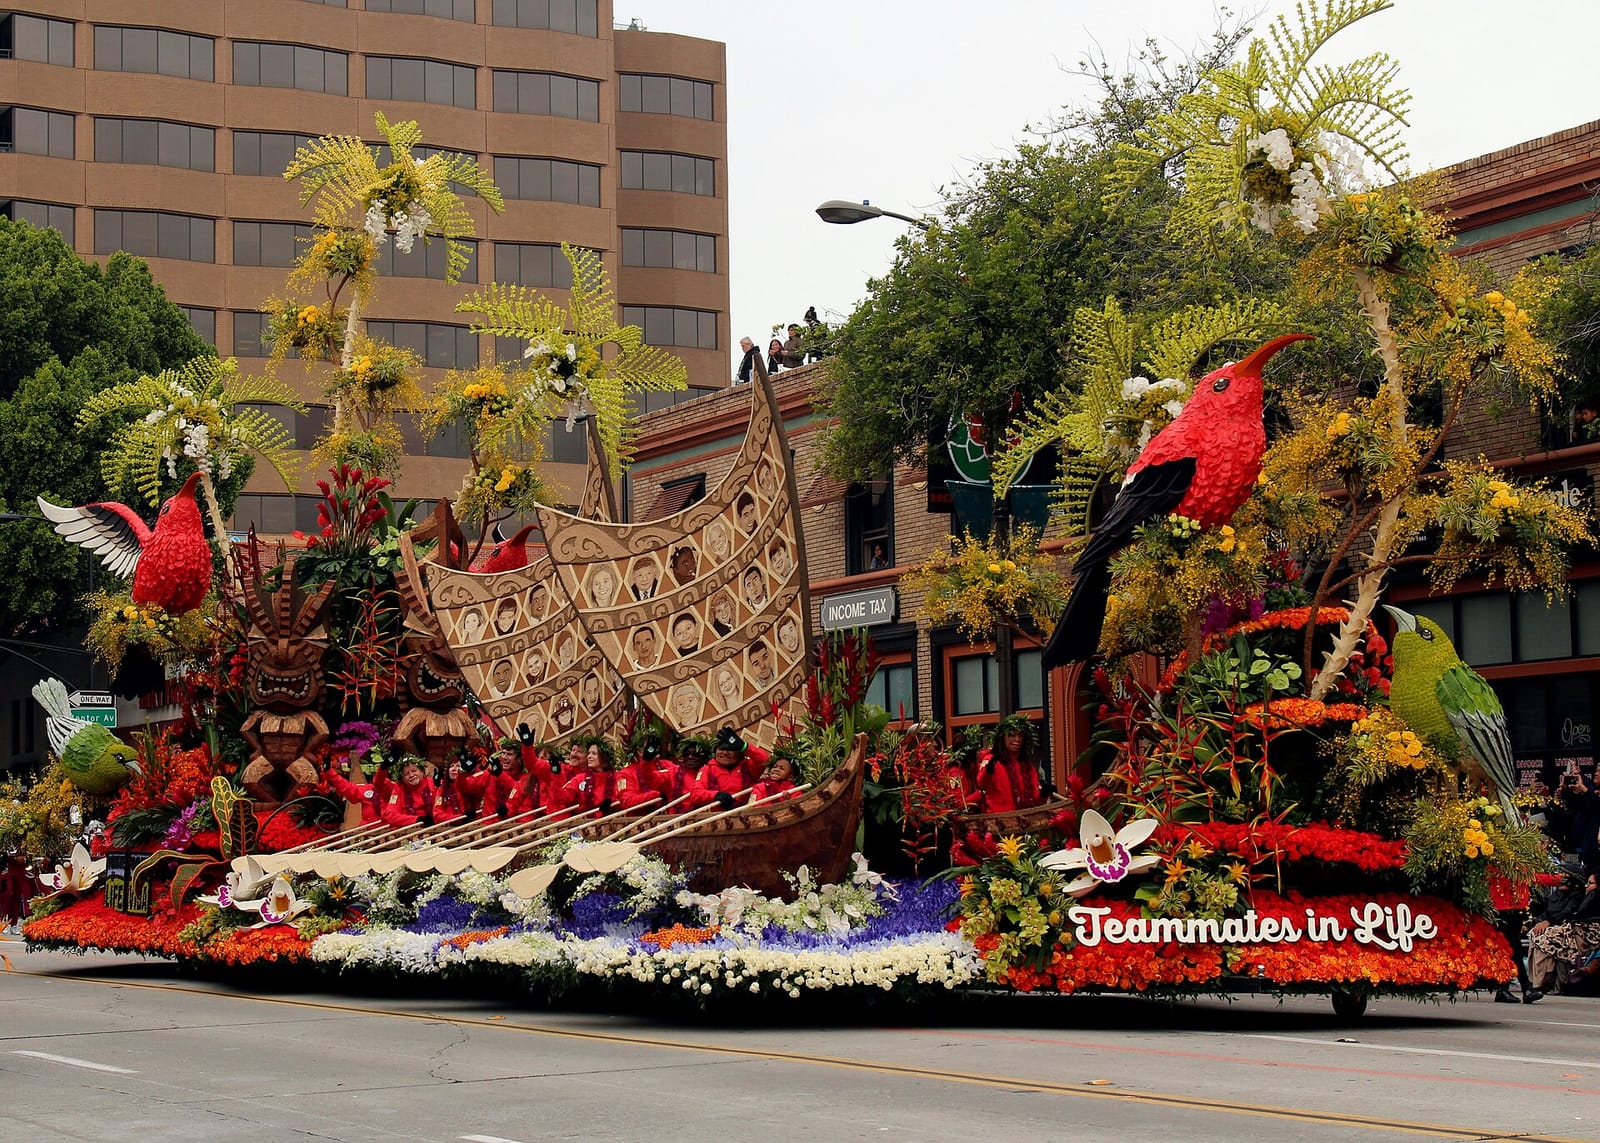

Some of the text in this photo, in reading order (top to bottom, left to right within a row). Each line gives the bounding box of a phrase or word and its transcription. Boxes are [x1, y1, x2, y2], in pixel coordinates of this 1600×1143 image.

[828, 598, 887, 622] INCOME TAX
[71, 714, 115, 722] entor Av
[1561, 717, 1592, 747] Open
[1068, 901, 1439, 953] Teammates in Life
